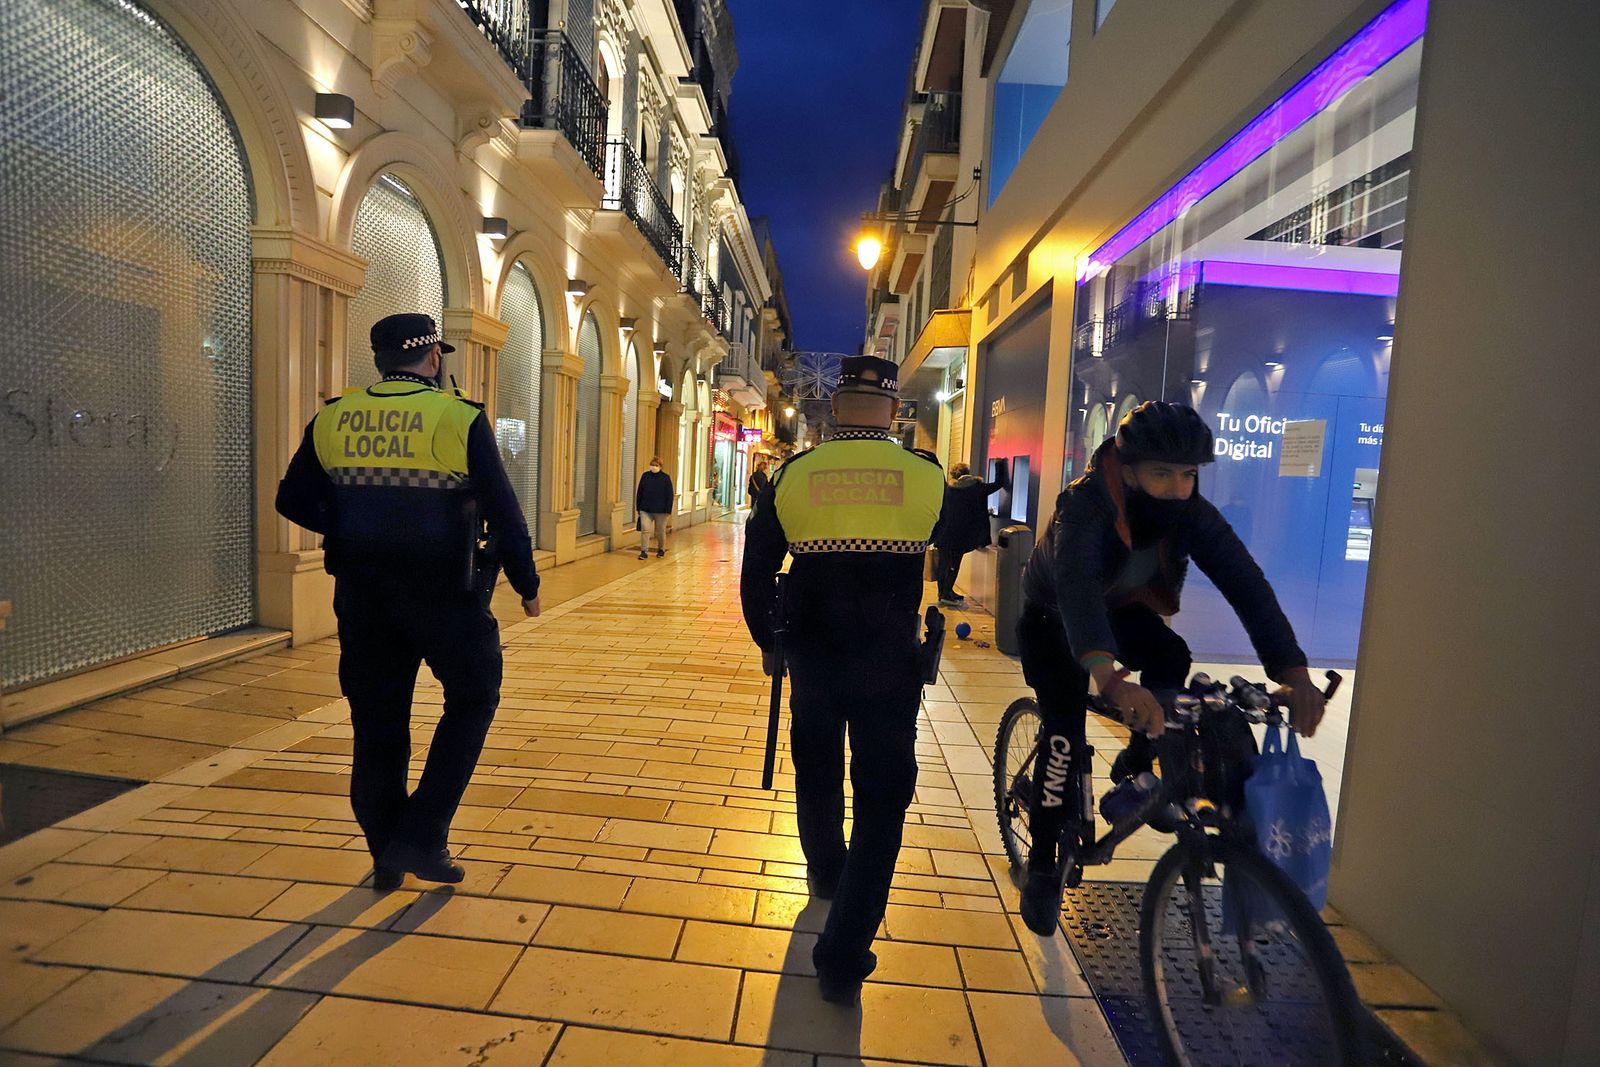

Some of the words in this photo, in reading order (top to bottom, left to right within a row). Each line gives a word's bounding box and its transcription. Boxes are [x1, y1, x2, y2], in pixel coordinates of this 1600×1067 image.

[991, 395, 1006, 418] BBVA
[337, 410, 424, 433] POLICIA
[1216, 412, 1241, 432] Tu
[1245, 414, 1287, 435] Ofici
[1359, 422, 1371, 433] Tu
[344, 435, 415, 458] LOCAL
[1214, 437, 1273, 461] Digital
[1358, 435, 1378, 445] más
[813, 471, 898, 488] POLICIA
[821, 487, 892, 503] LOCAL
[1041, 734, 1072, 808] CHINA
